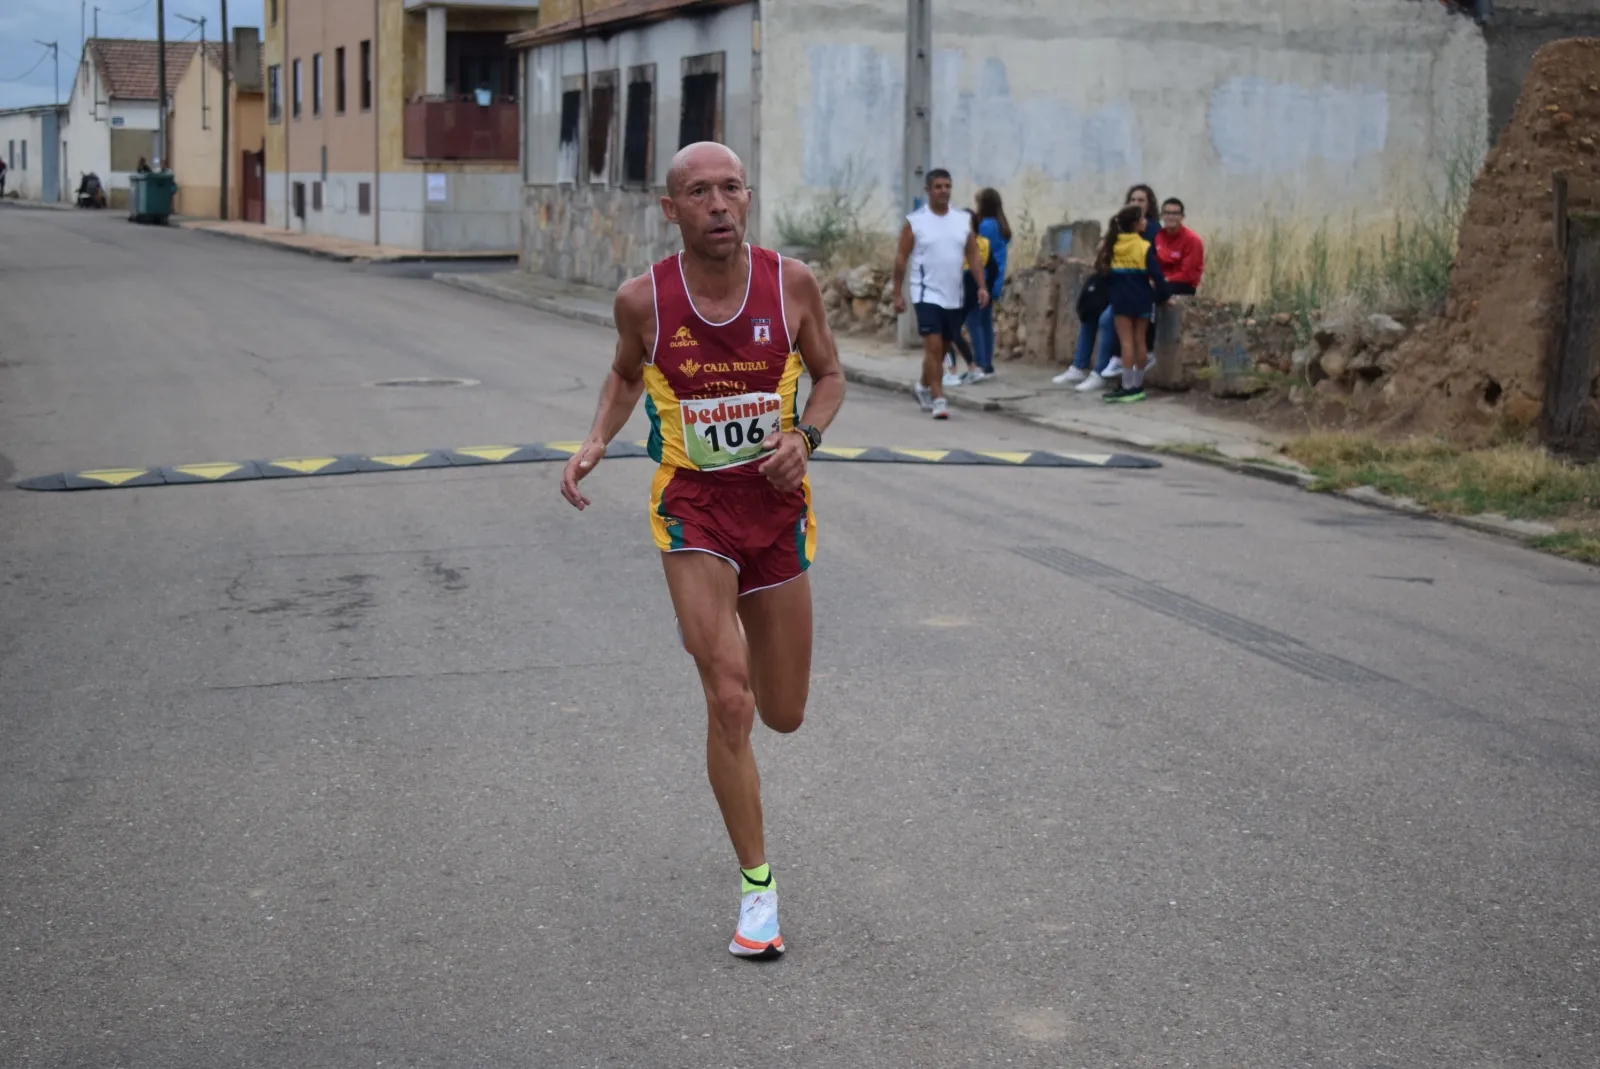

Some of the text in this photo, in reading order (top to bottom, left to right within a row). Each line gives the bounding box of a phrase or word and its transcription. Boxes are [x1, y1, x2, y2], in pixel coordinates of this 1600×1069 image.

[732, 361, 769, 372] RURAL
[704, 380, 746, 391] VINO
[683, 396, 780, 425] bedunia
[704, 418, 765, 452] 106
